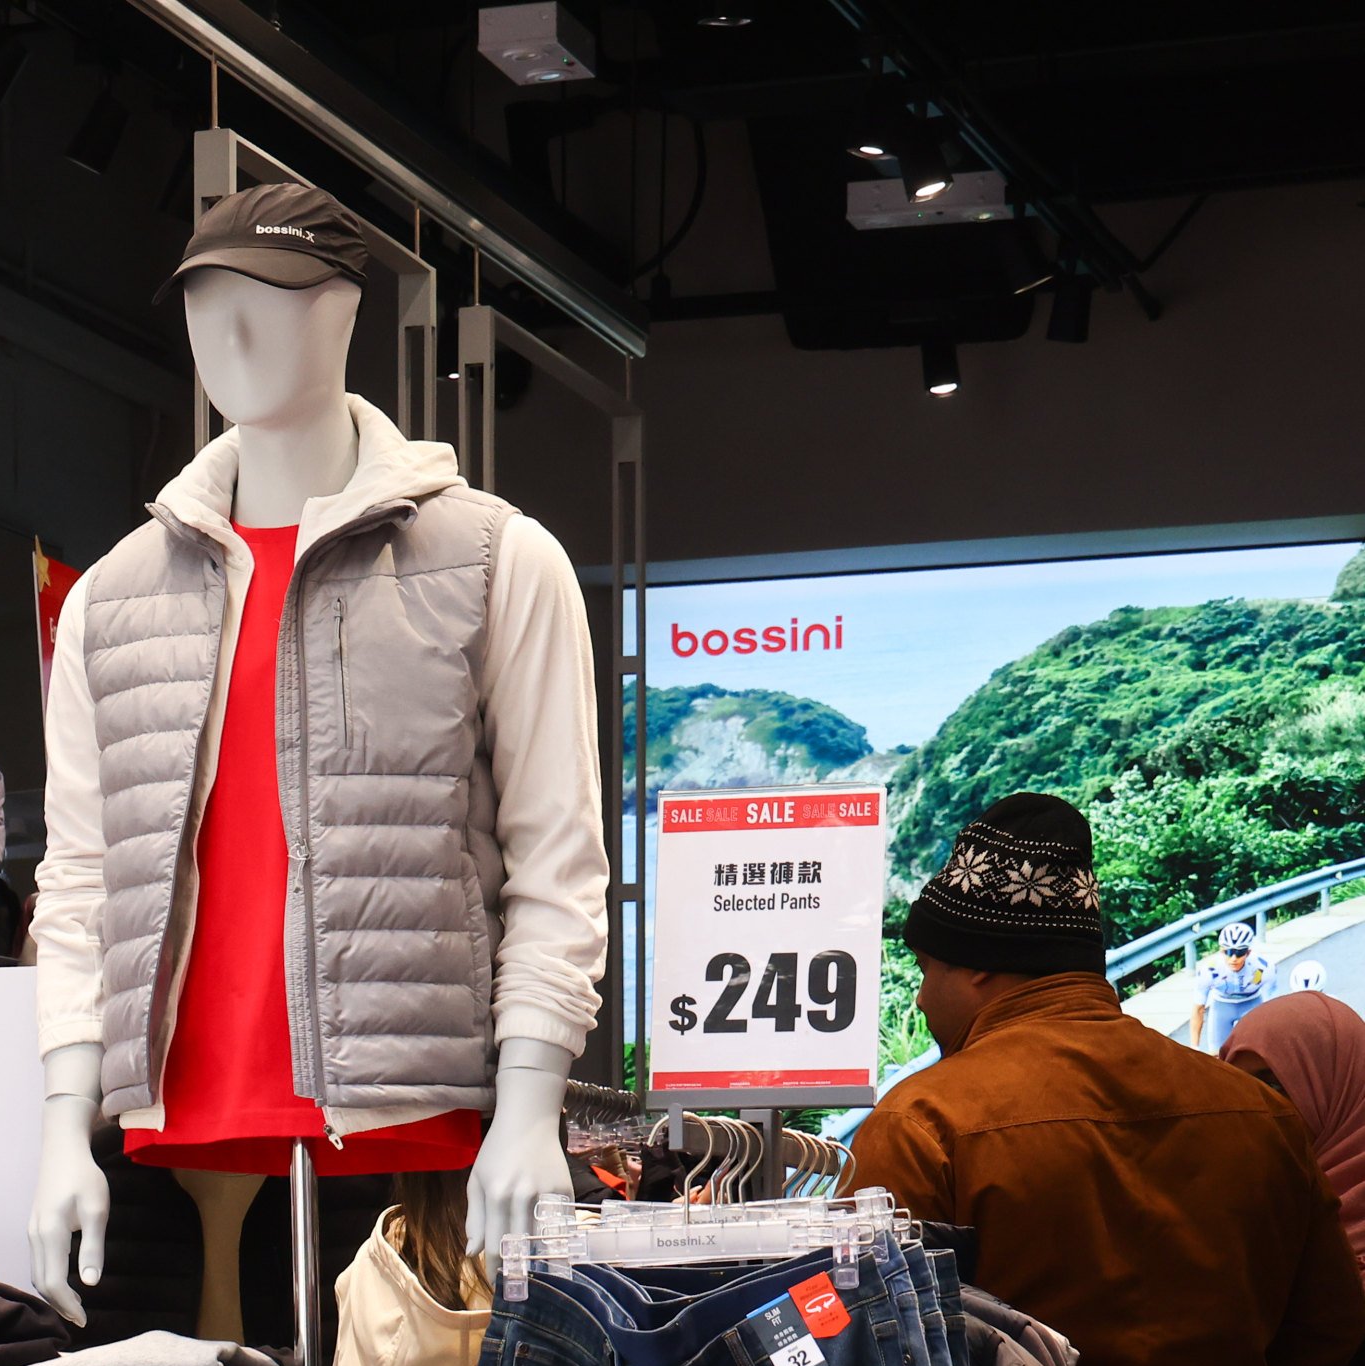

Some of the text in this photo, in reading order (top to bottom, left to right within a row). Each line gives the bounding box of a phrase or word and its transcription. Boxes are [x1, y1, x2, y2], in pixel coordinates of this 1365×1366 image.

[256, 224, 315, 244] bossini.X
[670, 615, 843, 658] bossini
[671, 802, 871, 824] SALE SALE SALE SALE SALE
[713, 861, 822, 887] 精選褲款
[713, 893, 820, 912] Selected Pants
[668, 949, 858, 1036] $249
[657, 1235, 715, 1248] bossini.X
[764, 1306, 782, 1321] SLIM
[771, 1316, 782, 1327] FIT
